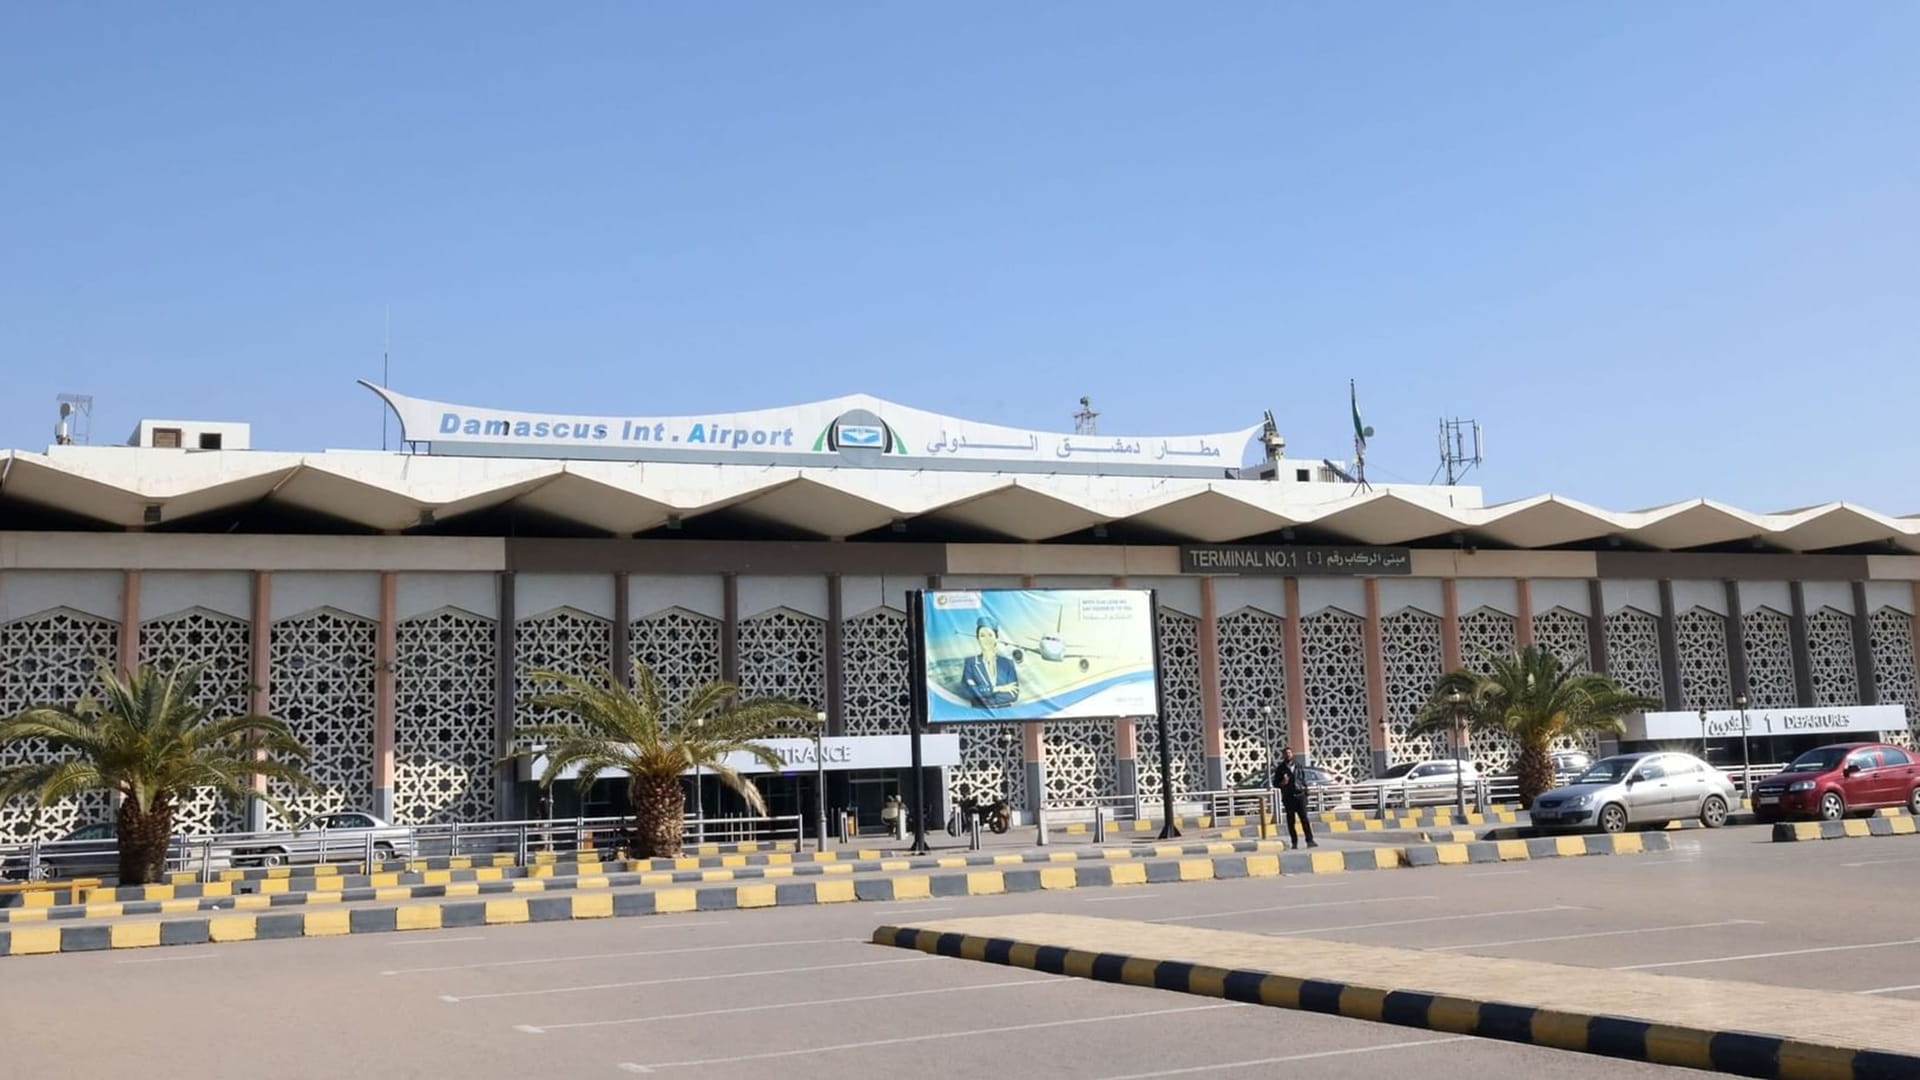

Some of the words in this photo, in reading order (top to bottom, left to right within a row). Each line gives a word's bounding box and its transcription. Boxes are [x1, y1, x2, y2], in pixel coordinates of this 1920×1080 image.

[440, 413, 608, 440] Damascus
[687, 423, 793, 448] Airport
[926, 430, 1039, 456] الدولي
[1056, 438, 1141, 458] دمشق
[1155, 439, 1221, 460] مطار
[1189, 550, 1263, 567] TERMINAL
[1264, 551, 1297, 567] NO.1
[1344, 552, 1381, 566] الركاب
[1783, 713, 1851, 730] DEPARTURES
